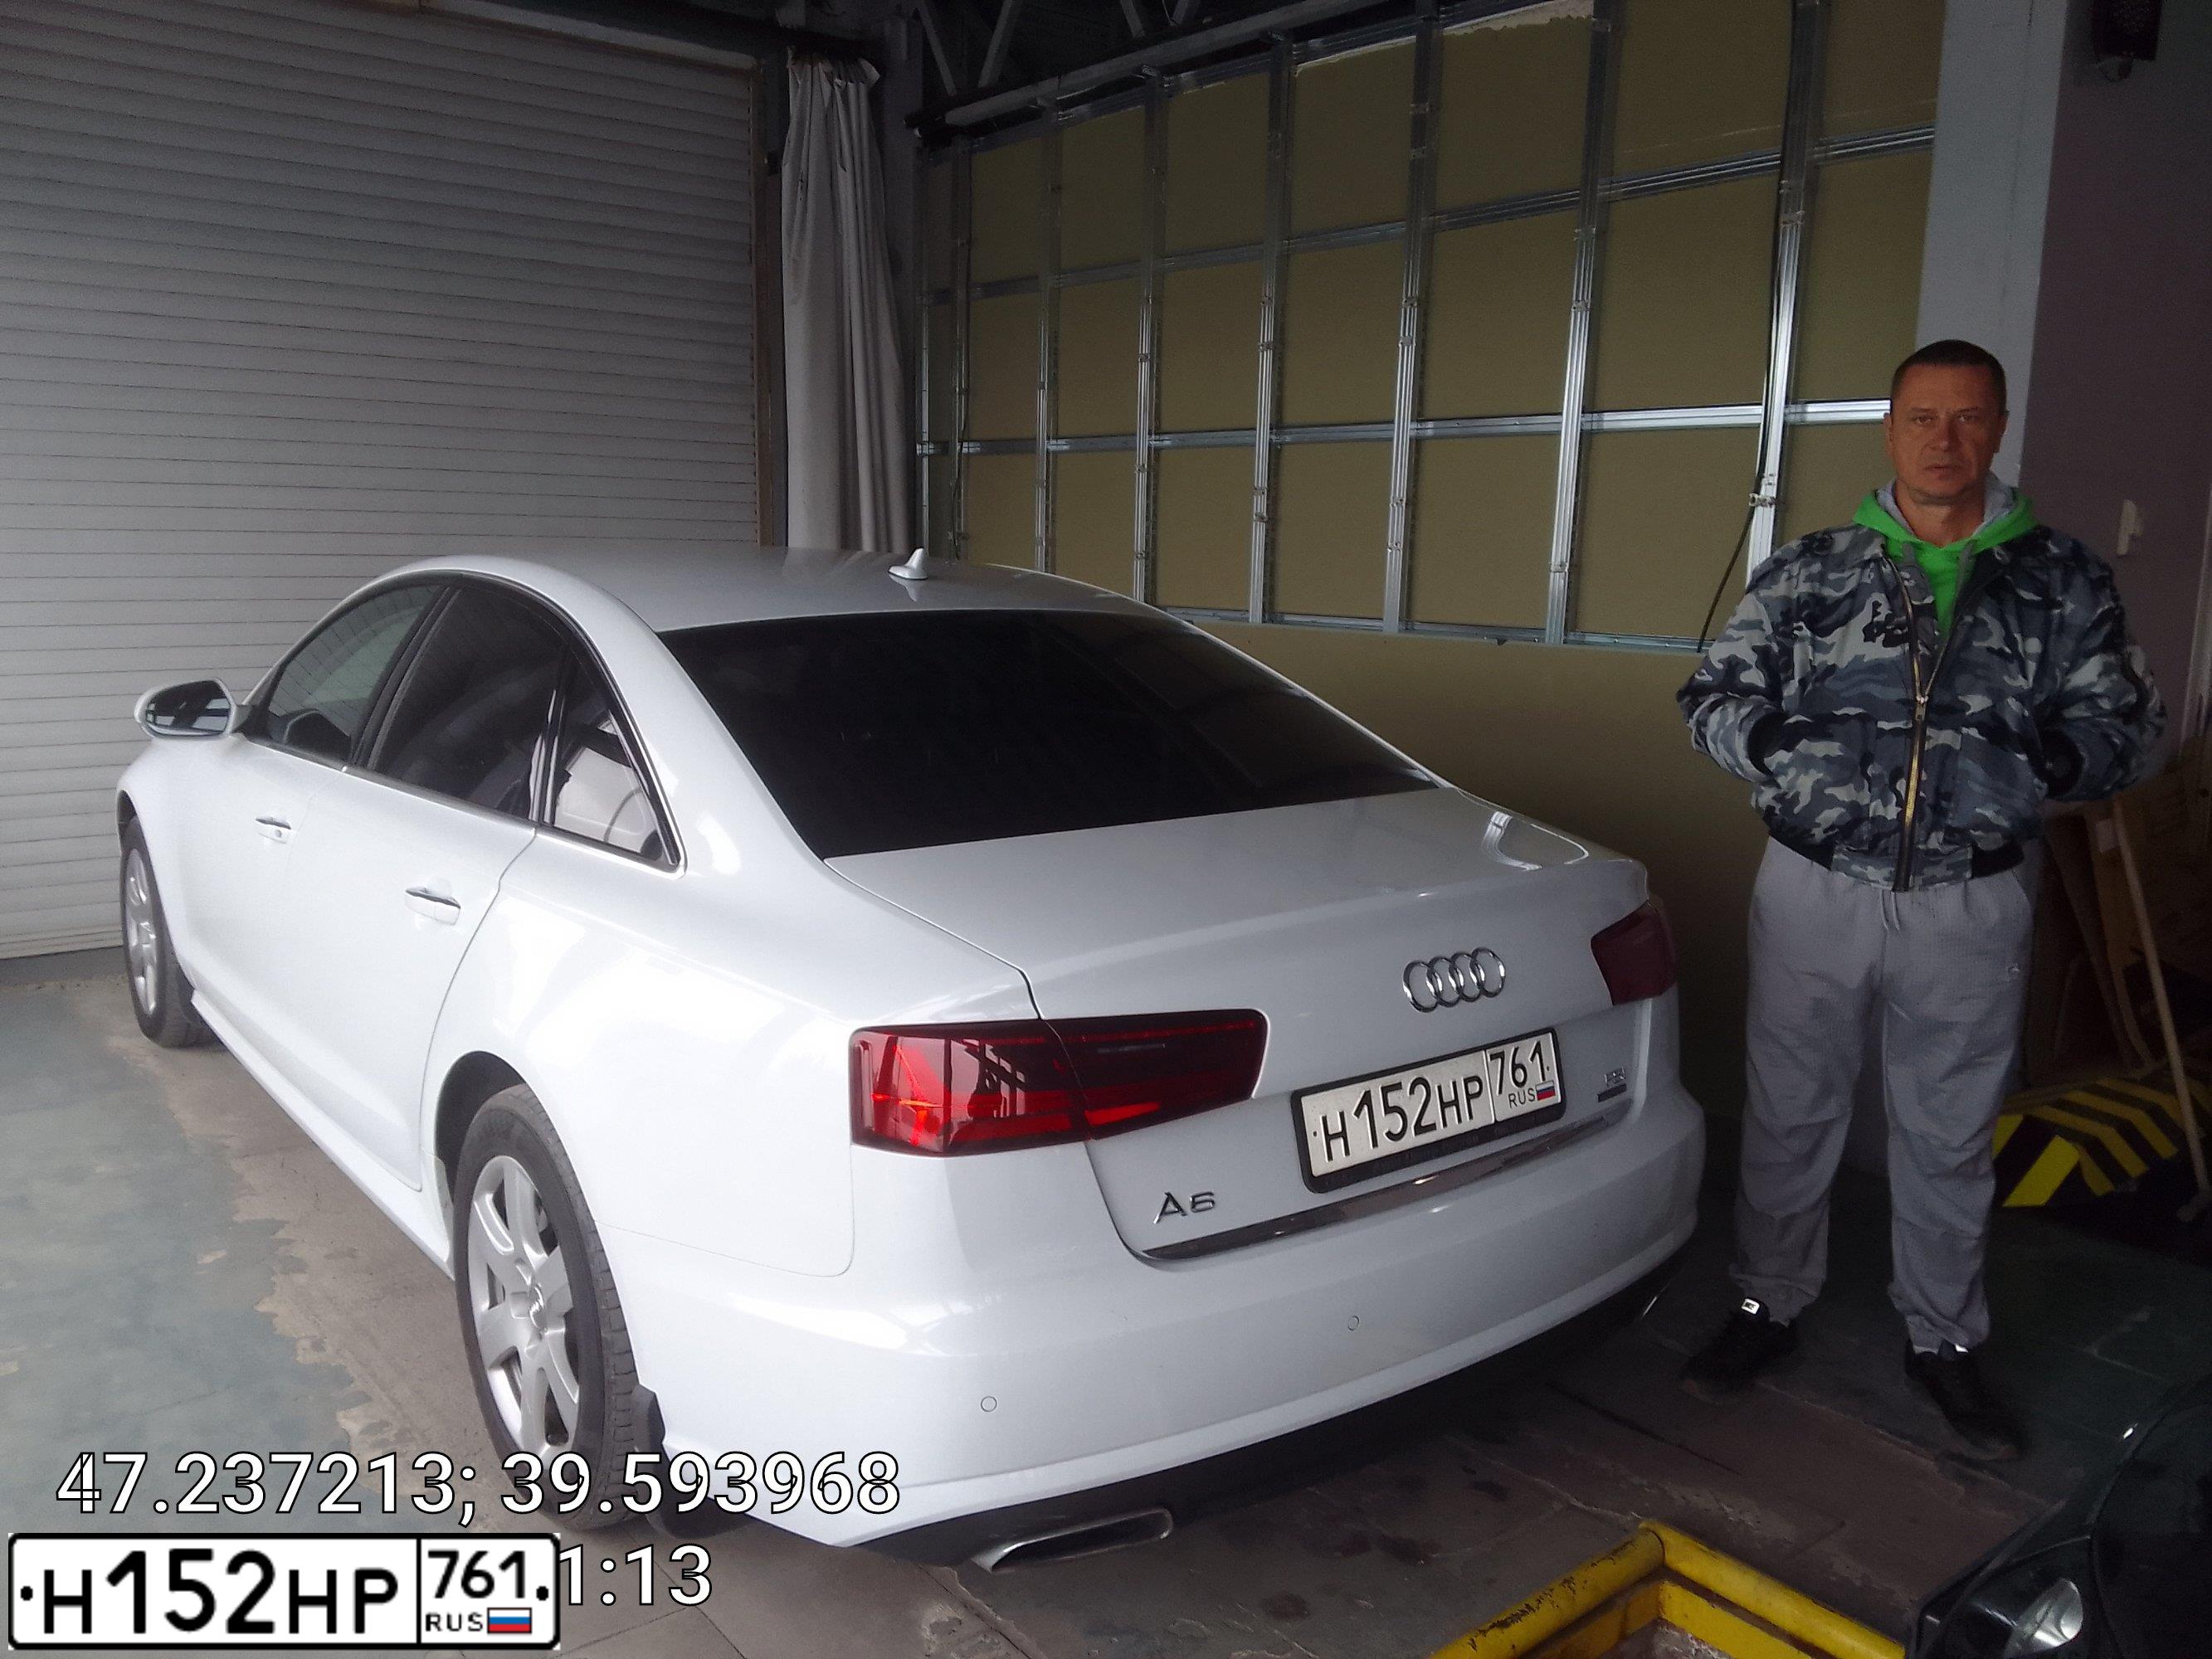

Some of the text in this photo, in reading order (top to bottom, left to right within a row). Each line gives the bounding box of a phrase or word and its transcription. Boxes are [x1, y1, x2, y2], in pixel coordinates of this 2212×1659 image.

[1489, 1041, 1547, 1096] 761
[1508, 1087, 1535, 1108] RUS
[1153, 1191, 1215, 1224] A6
